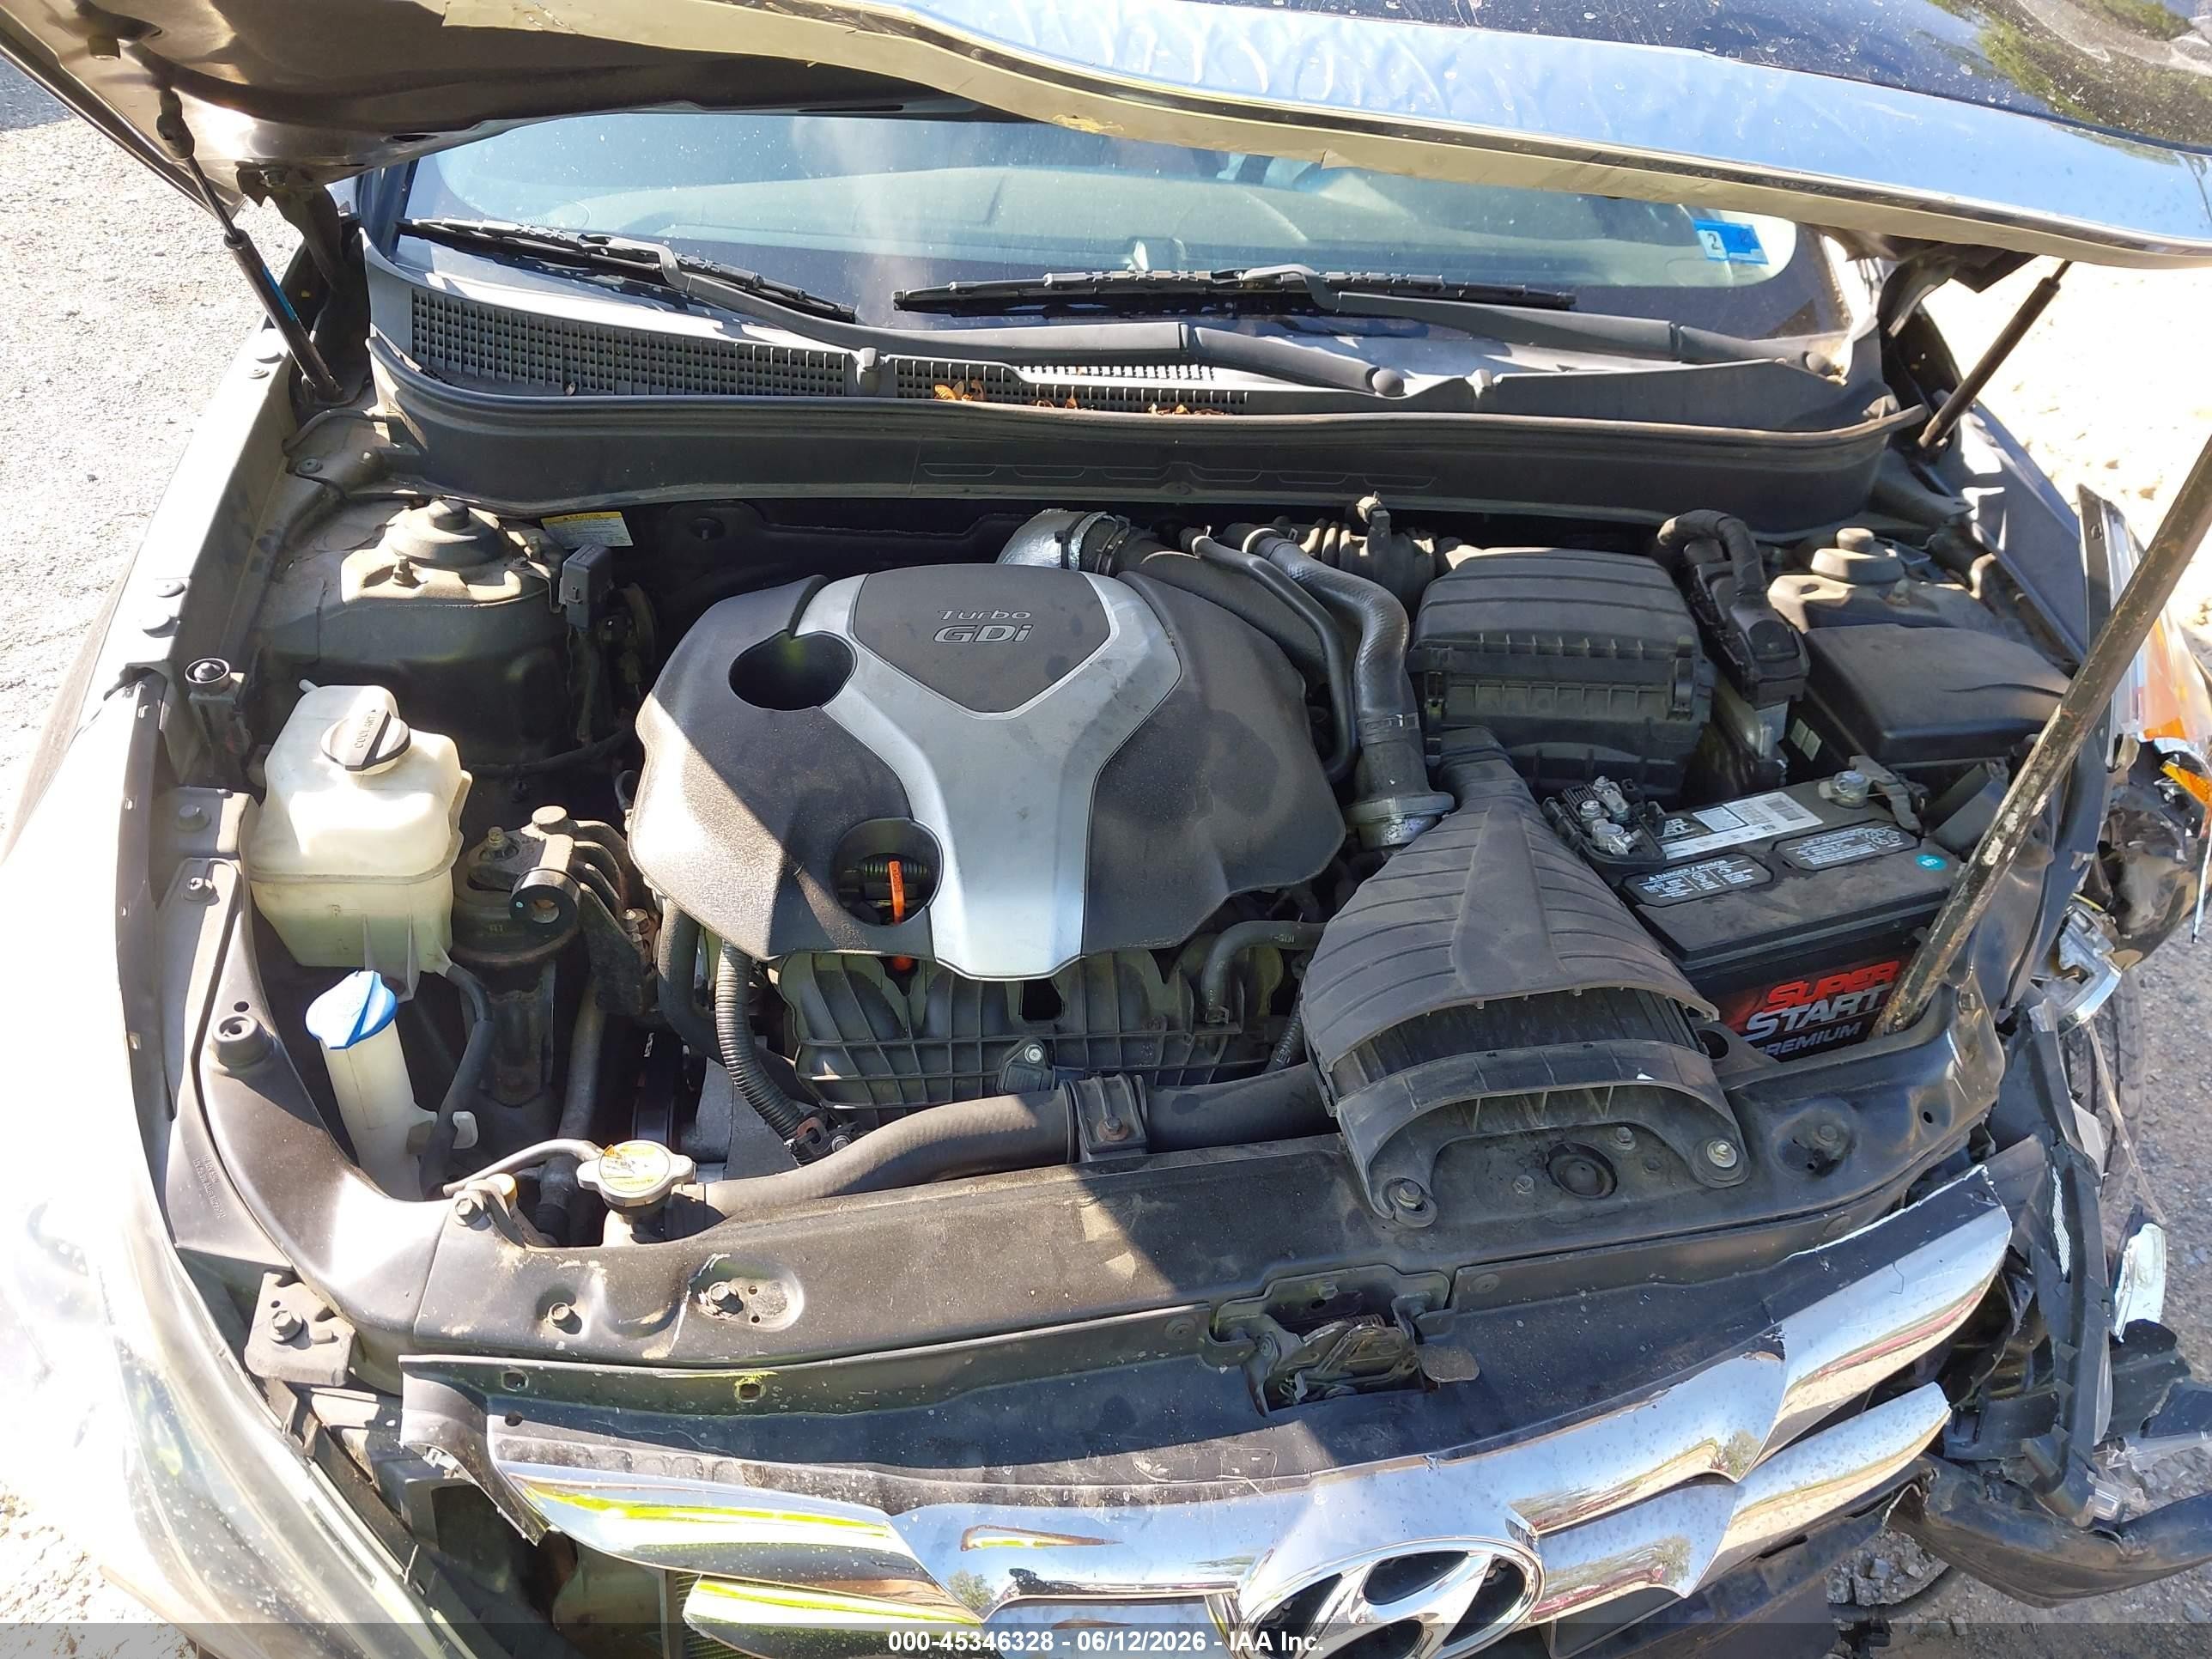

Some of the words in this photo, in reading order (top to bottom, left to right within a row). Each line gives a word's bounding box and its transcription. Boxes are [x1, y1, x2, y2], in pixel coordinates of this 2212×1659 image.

[938, 609, 1031, 620] Turbo
[933, 624, 1033, 643] GDi
[1656, 868, 1690, 879] DANGER
[1696, 860, 1728, 870] POISON
[1764, 961, 1899, 1012] SUPER
[1744, 985, 1888, 1042] START
